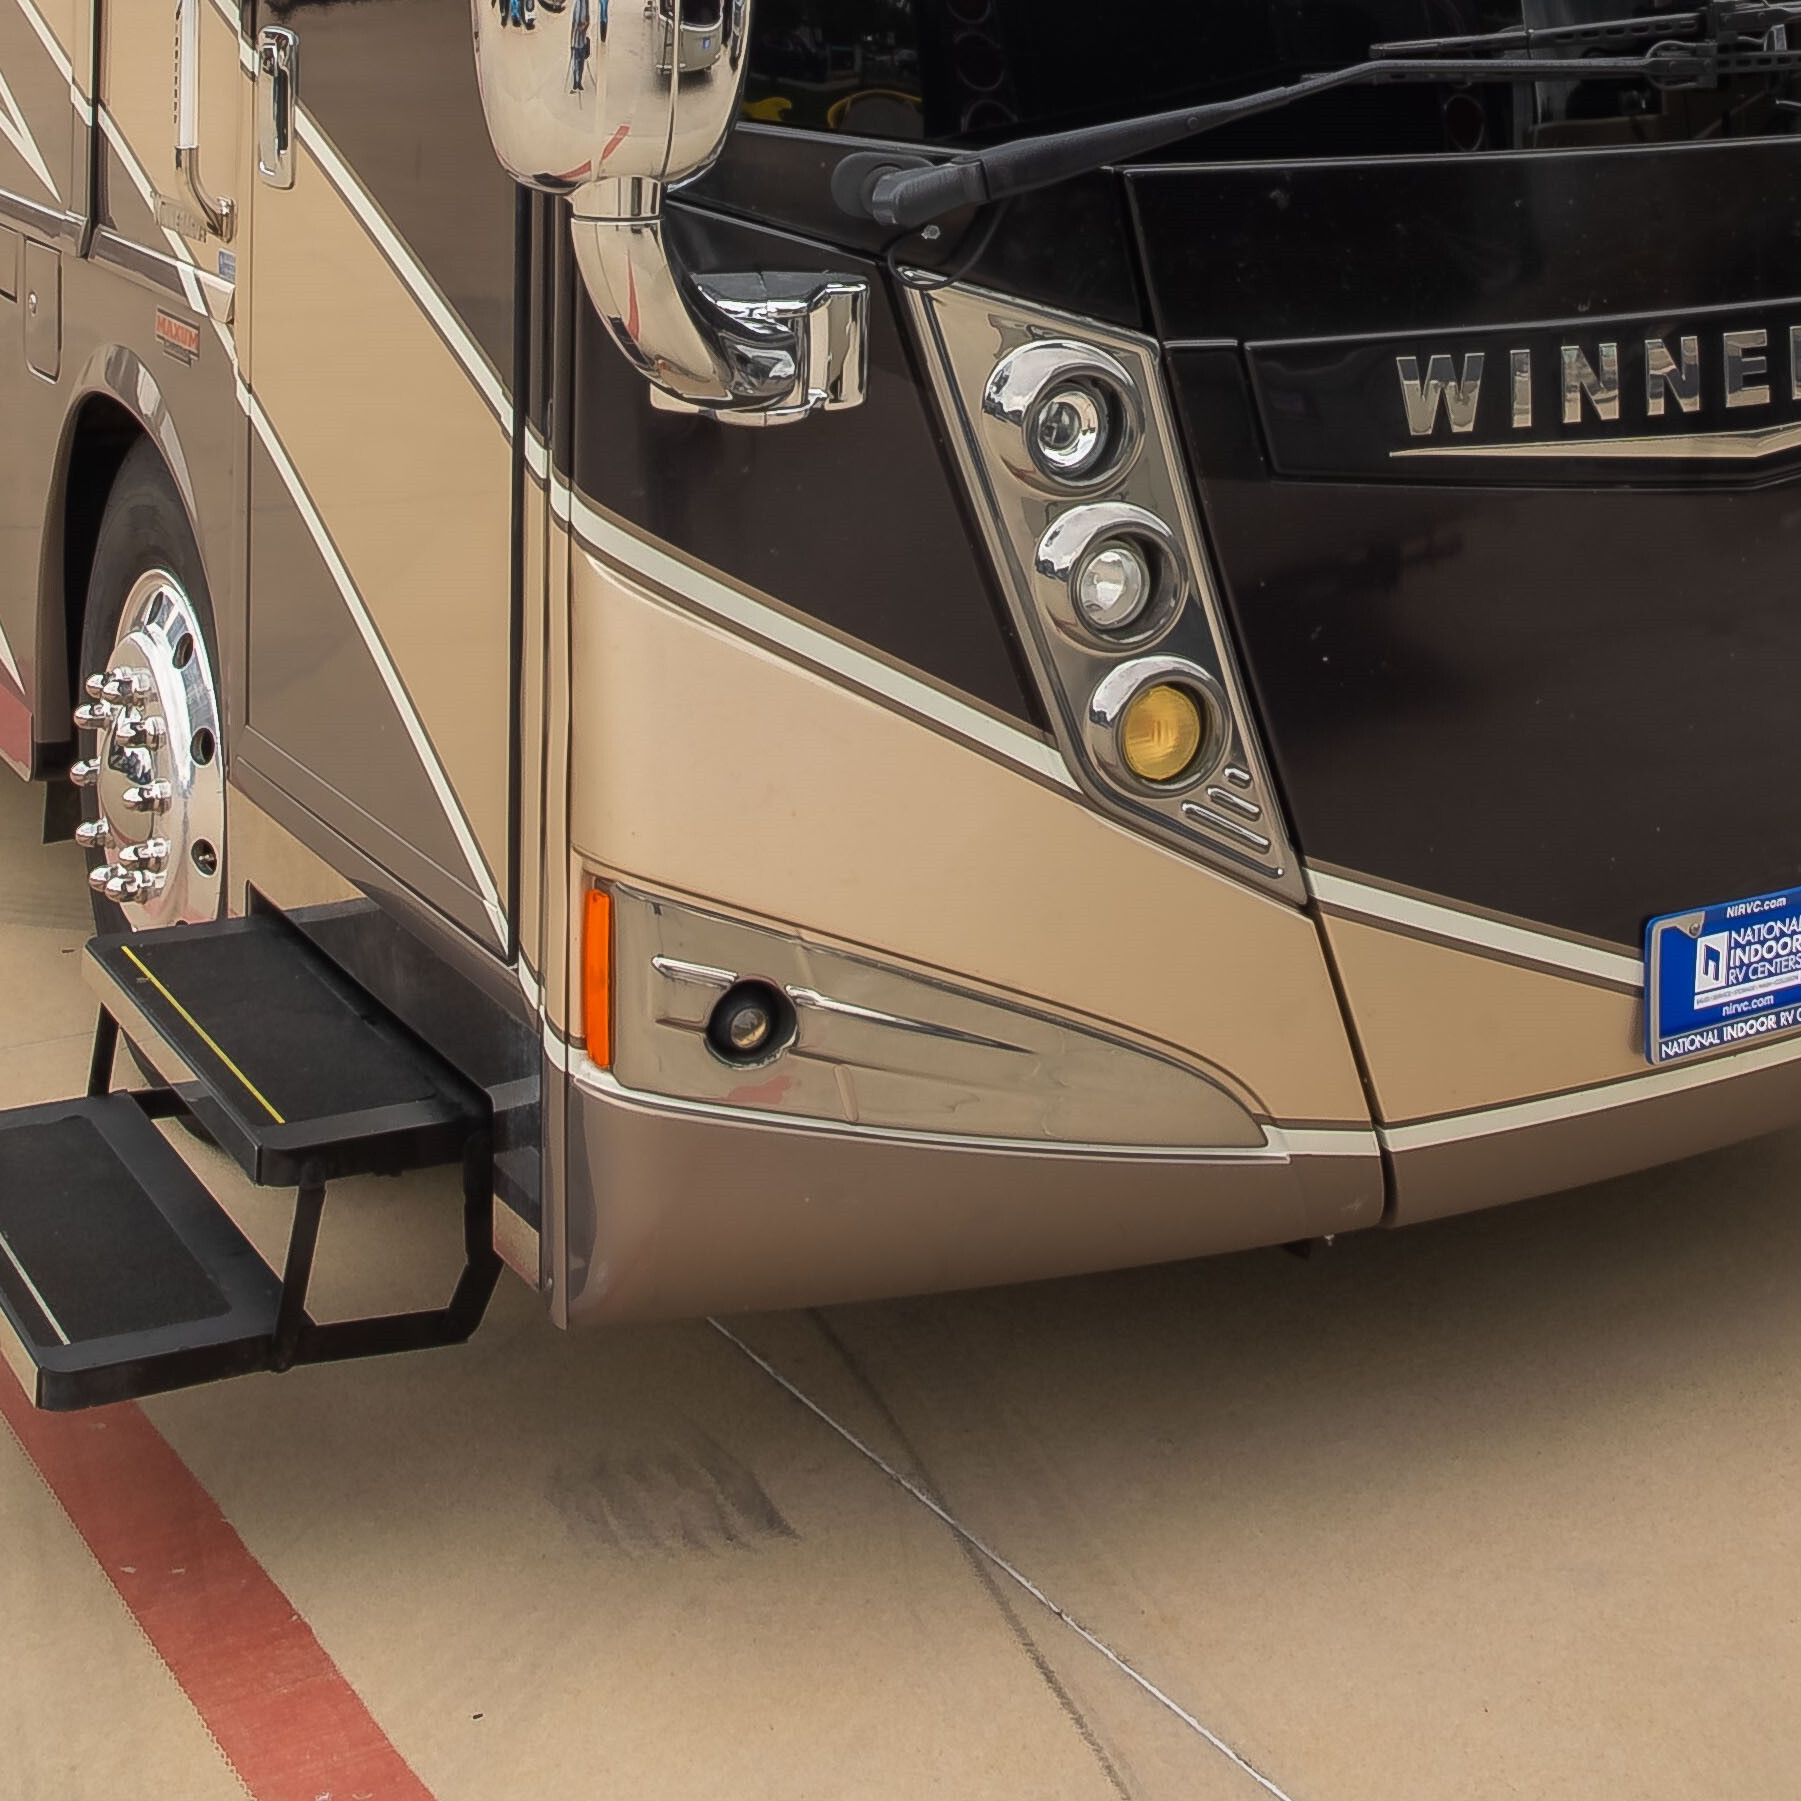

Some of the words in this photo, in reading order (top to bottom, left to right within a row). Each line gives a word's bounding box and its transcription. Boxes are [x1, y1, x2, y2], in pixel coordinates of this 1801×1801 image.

[1726, 897, 1787, 919] NIRVC.com
[1728, 966, 1747, 985] RV
[1722, 994, 1775, 1017] nirvc.com
[1661, 1031, 1721, 1059] NATIONAL
[1723, 1014, 1777, 1042] INDOOR
[1780, 1009, 1794, 1027] RV
